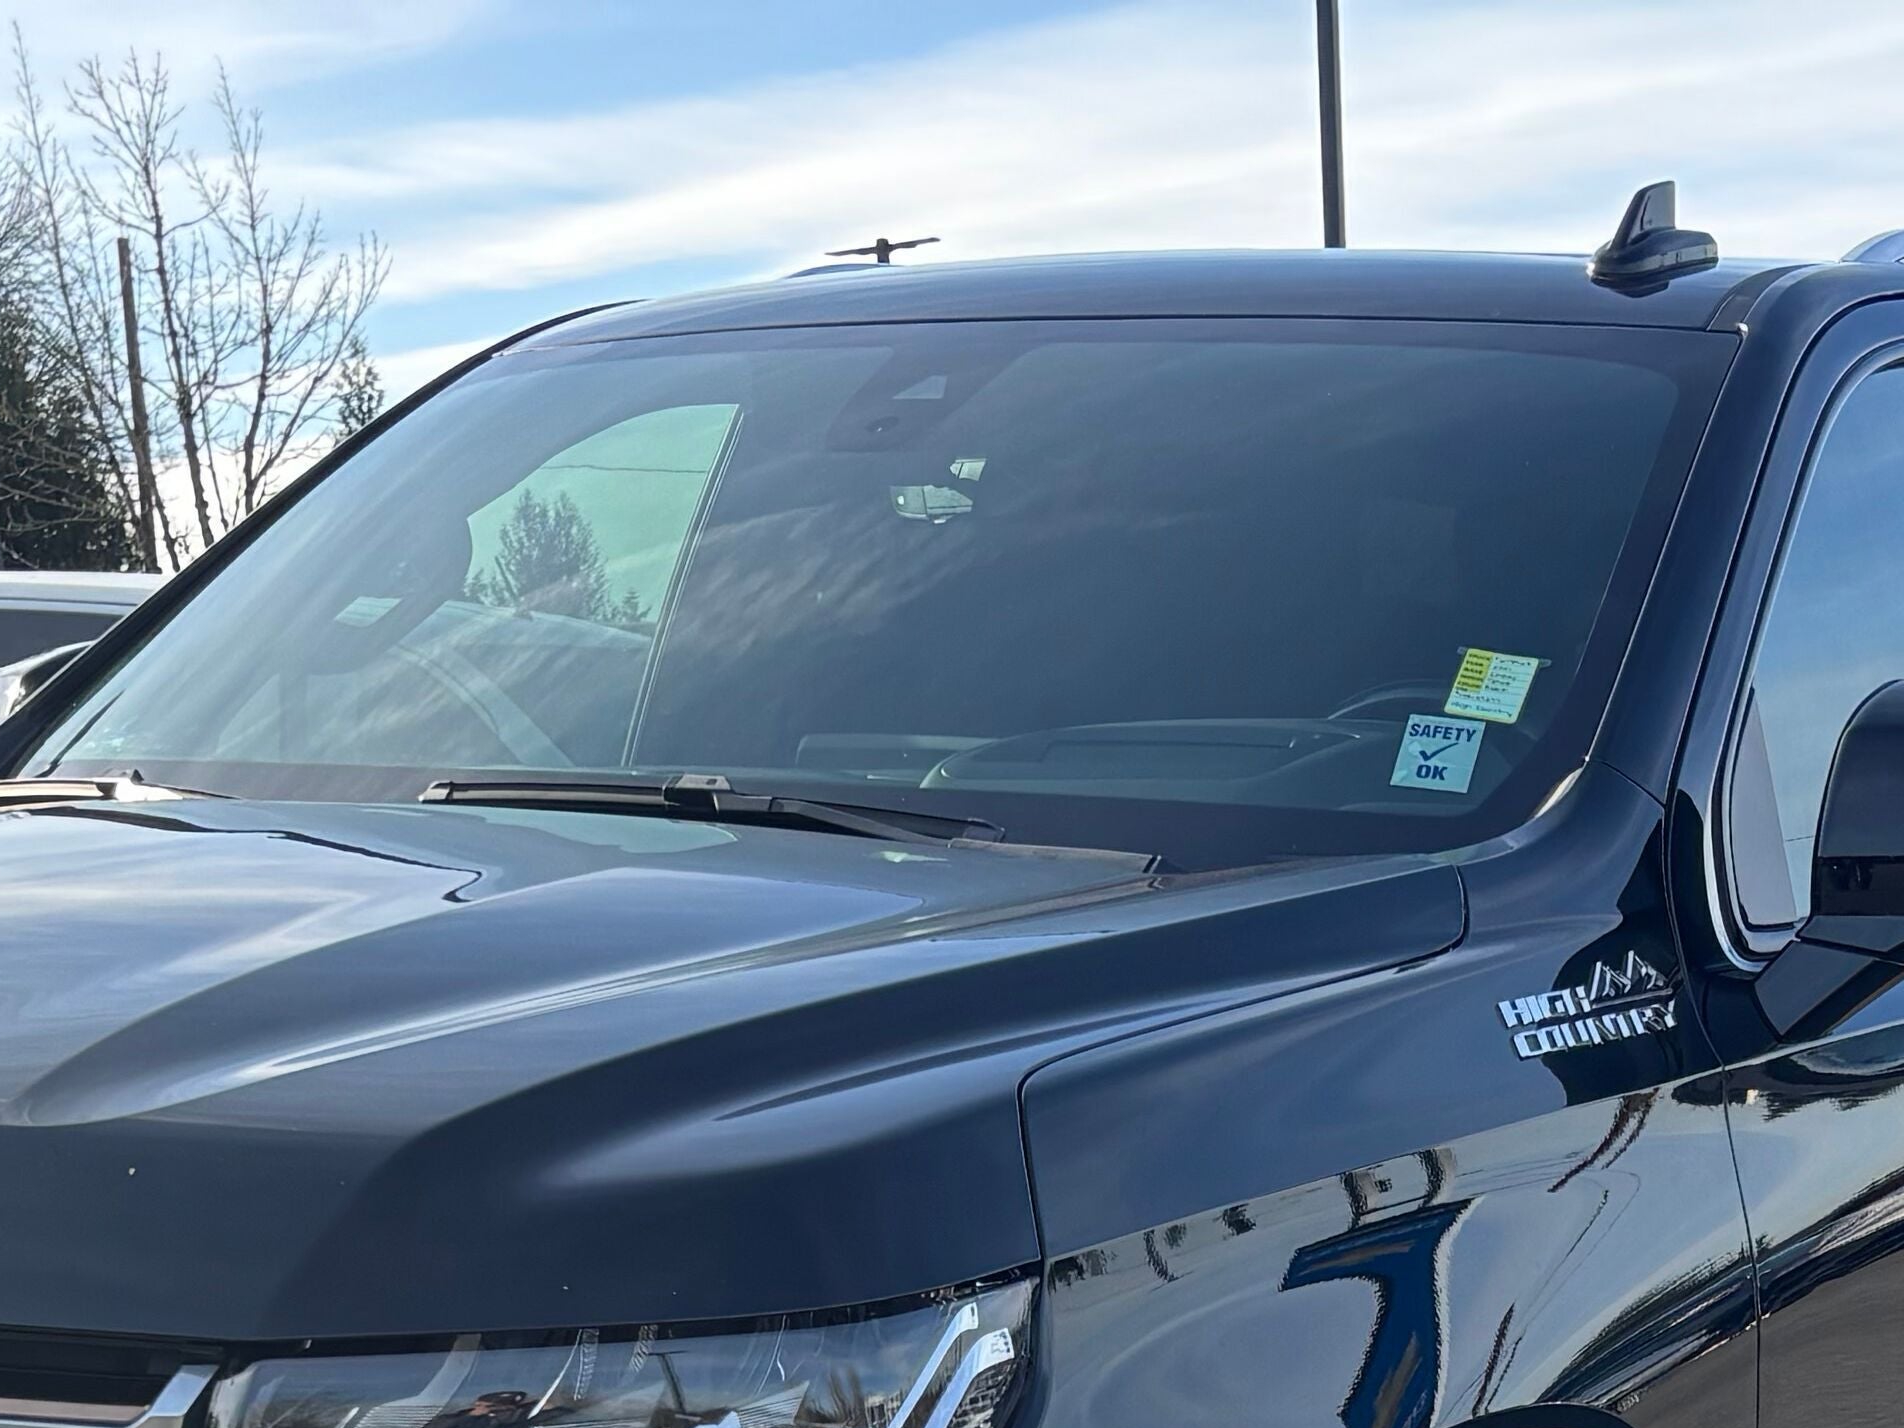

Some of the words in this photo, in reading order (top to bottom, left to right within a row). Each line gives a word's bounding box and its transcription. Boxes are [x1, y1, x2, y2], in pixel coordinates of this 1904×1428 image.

[1409, 723, 1476, 742] SAFETY
[1416, 764, 1448, 780] OK
[1498, 986, 1591, 1028] HIGH
[1513, 999, 1678, 1058] COUNTRY
